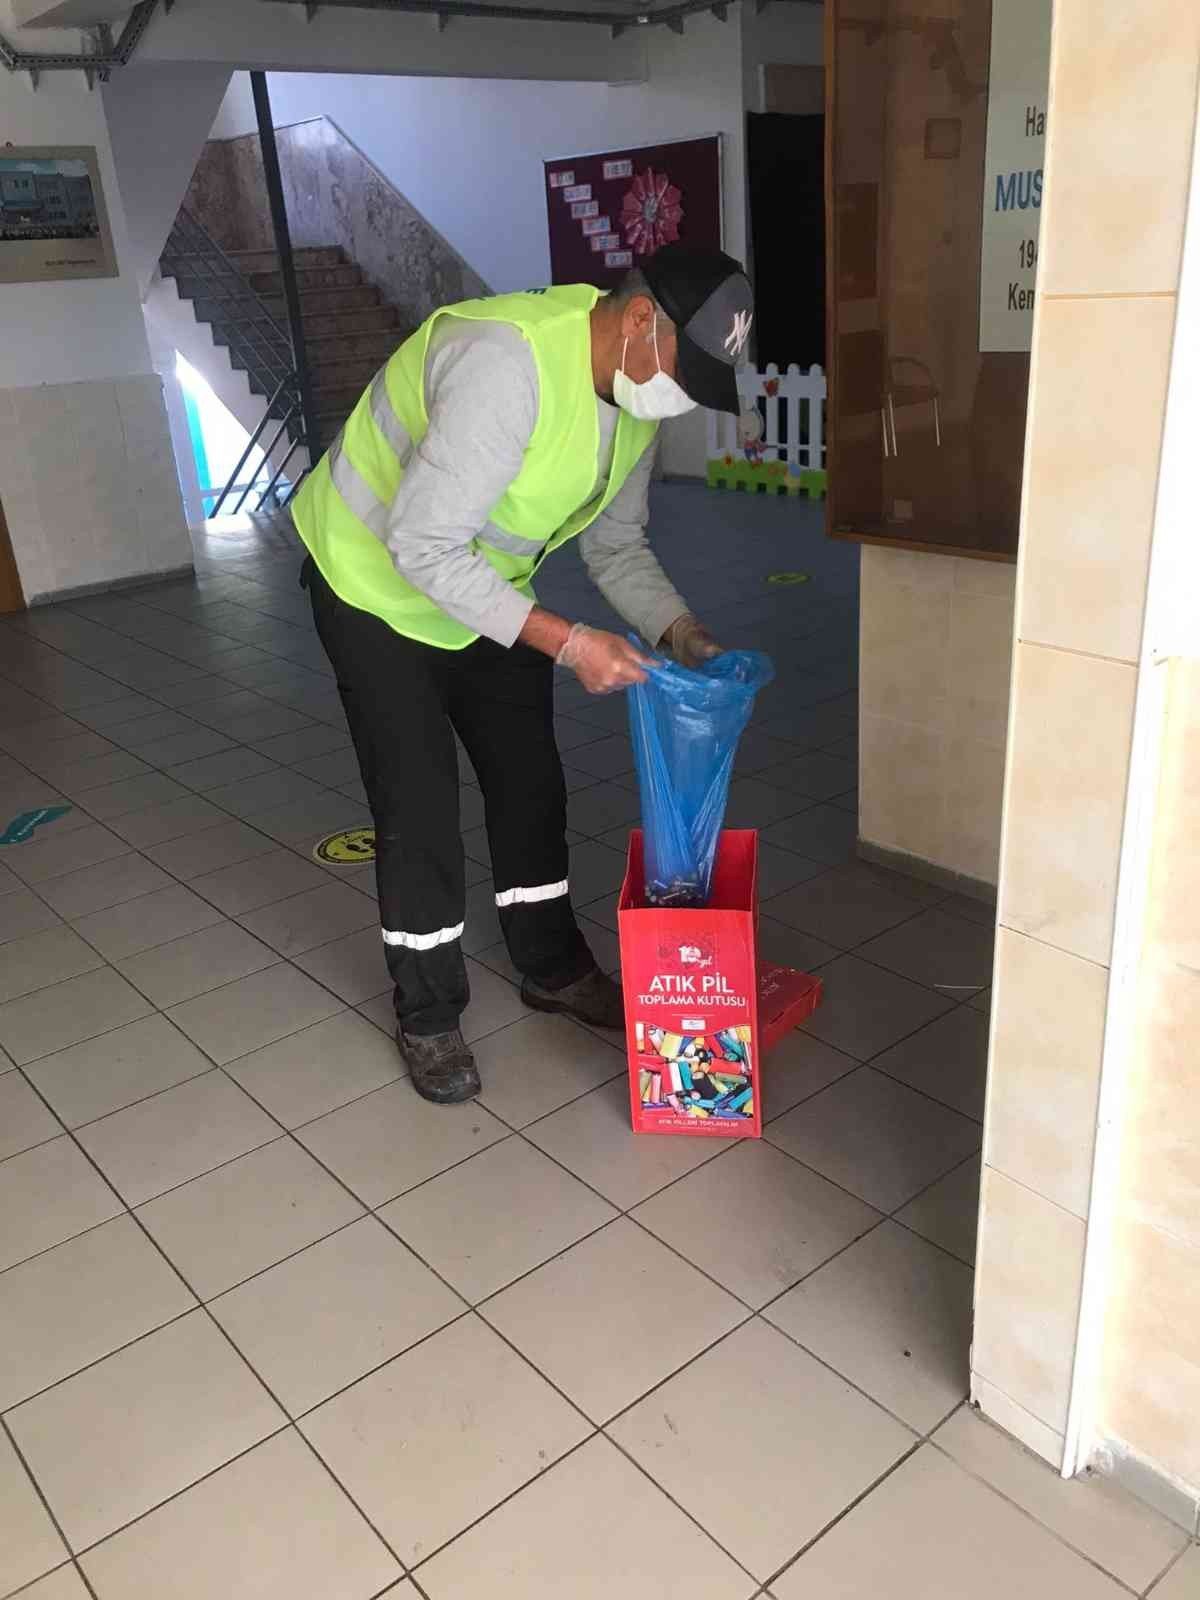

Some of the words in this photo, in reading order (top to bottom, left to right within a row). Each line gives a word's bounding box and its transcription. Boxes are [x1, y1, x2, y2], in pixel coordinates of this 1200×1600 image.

[1025, 105, 1047, 136] Ha
[1018, 239, 1038, 268] 19
[649, 975, 696, 992] ATIK
[702, 972, 735, 993] PİL
[638, 995, 695, 1005] TOPLAMA
[697, 995, 746, 1006] KUTUSU
